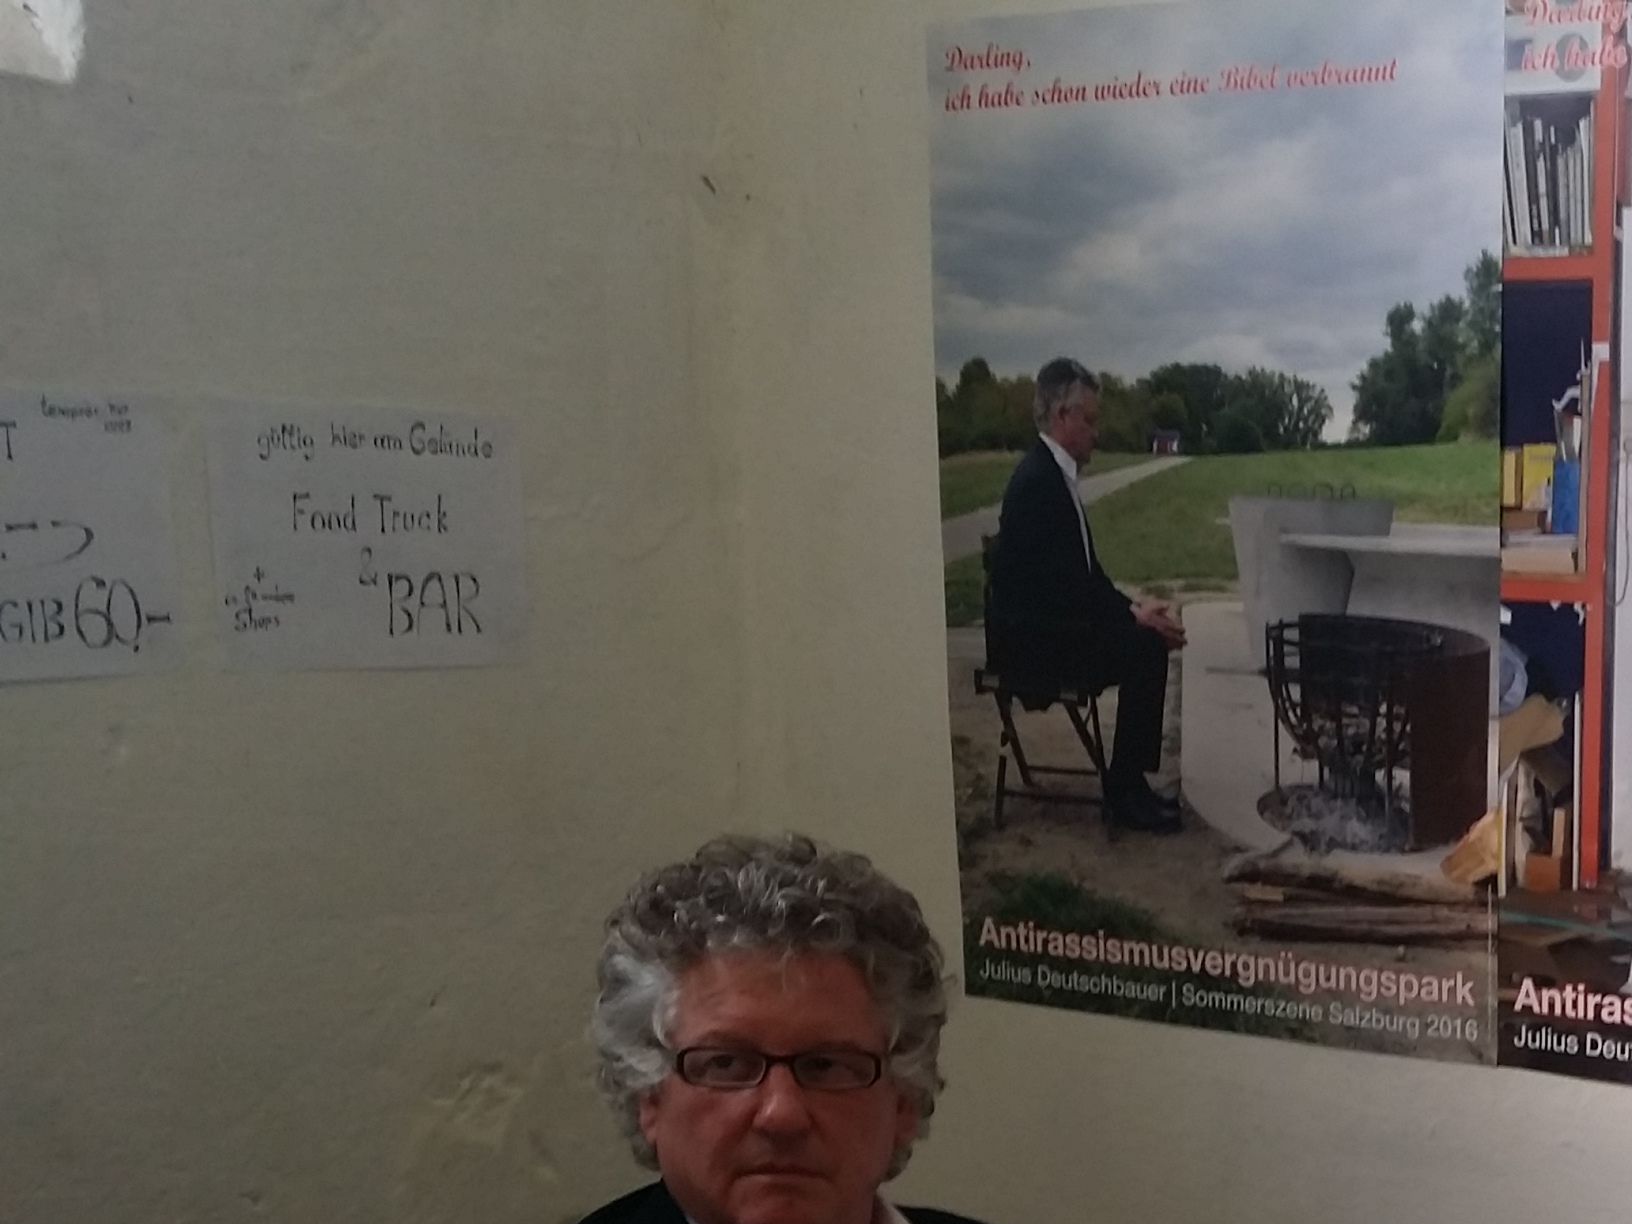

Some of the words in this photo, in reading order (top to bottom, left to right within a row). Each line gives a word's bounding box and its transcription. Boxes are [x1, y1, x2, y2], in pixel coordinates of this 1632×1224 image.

[944, 43, 1032, 74] Darling,
[1521, 43, 1558, 70] ich
[1564, 34, 1627, 69] habe
[944, 87, 973, 112] ich
[977, 82, 1025, 109] habe
[1031, 77, 1088, 105] schon
[1094, 70, 1163, 102] wieder
[1169, 70, 1210, 96] eine
[1218, 62, 1278, 92] Bibel
[1285, 57, 1397, 89] verbrannt
[330, 421, 366, 450] hier
[292, 491, 358, 532] Food
[372, 492, 450, 535] Truck
[387, 570, 484, 637] BAR
[979, 916, 1475, 1007] Antirassismusvergnügungspark
[979, 958, 1033, 986] Julius
[1037, 965, 1168, 1003] Deutschbauer
[1181, 982, 1323, 1024] Sommerszene
[1329, 1001, 1420, 1038] Salzburg
[1426, 1012, 1479, 1042] 2016
[1513, 1024, 1580, 1057] Julius
